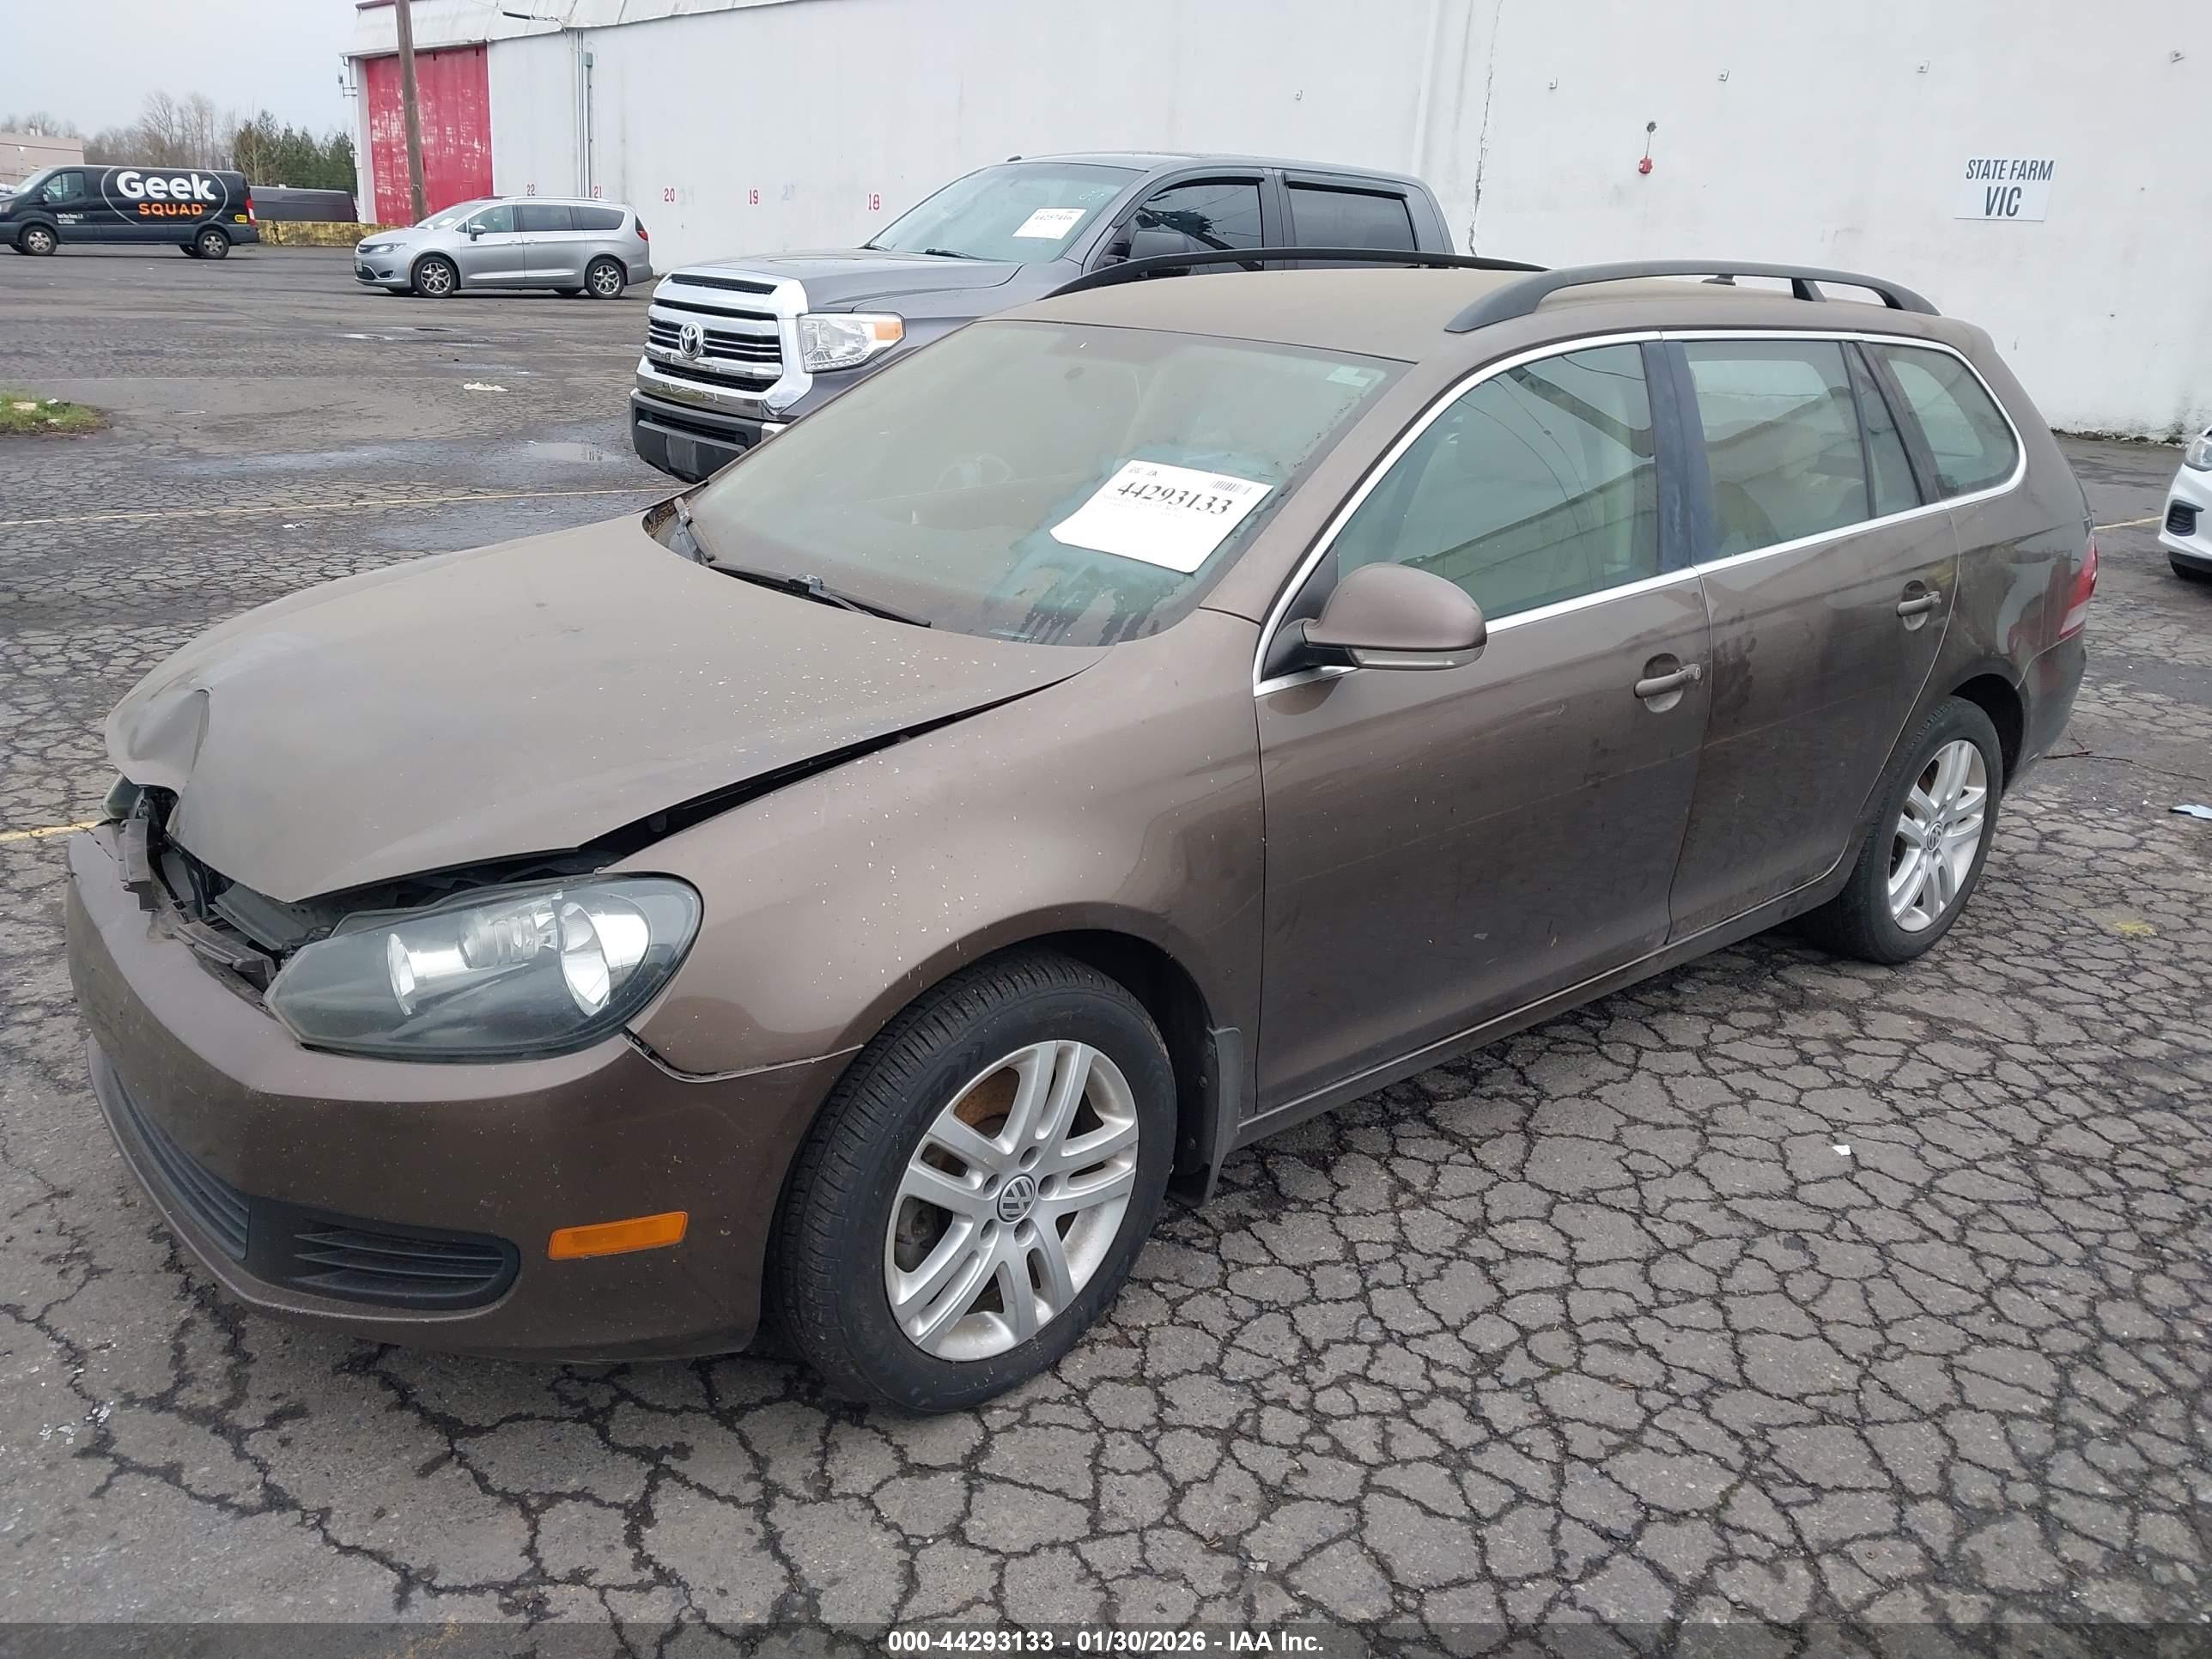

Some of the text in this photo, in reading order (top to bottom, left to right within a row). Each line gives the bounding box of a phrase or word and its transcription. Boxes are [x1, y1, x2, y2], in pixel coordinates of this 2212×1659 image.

[1966, 159, 2055, 181] STATE FARM
[116, 170, 217, 201] Geek
[526, 184, 536, 197] 22
[594, 185, 603, 198] 21
[664, 187, 676, 203] 20
[749, 189, 759, 205] 19
[868, 193, 880, 211] 18
[1984, 185, 2022, 217] VIC
[137, 203, 204, 216] SQUAD
[1117, 482, 1232, 514] 44293133
